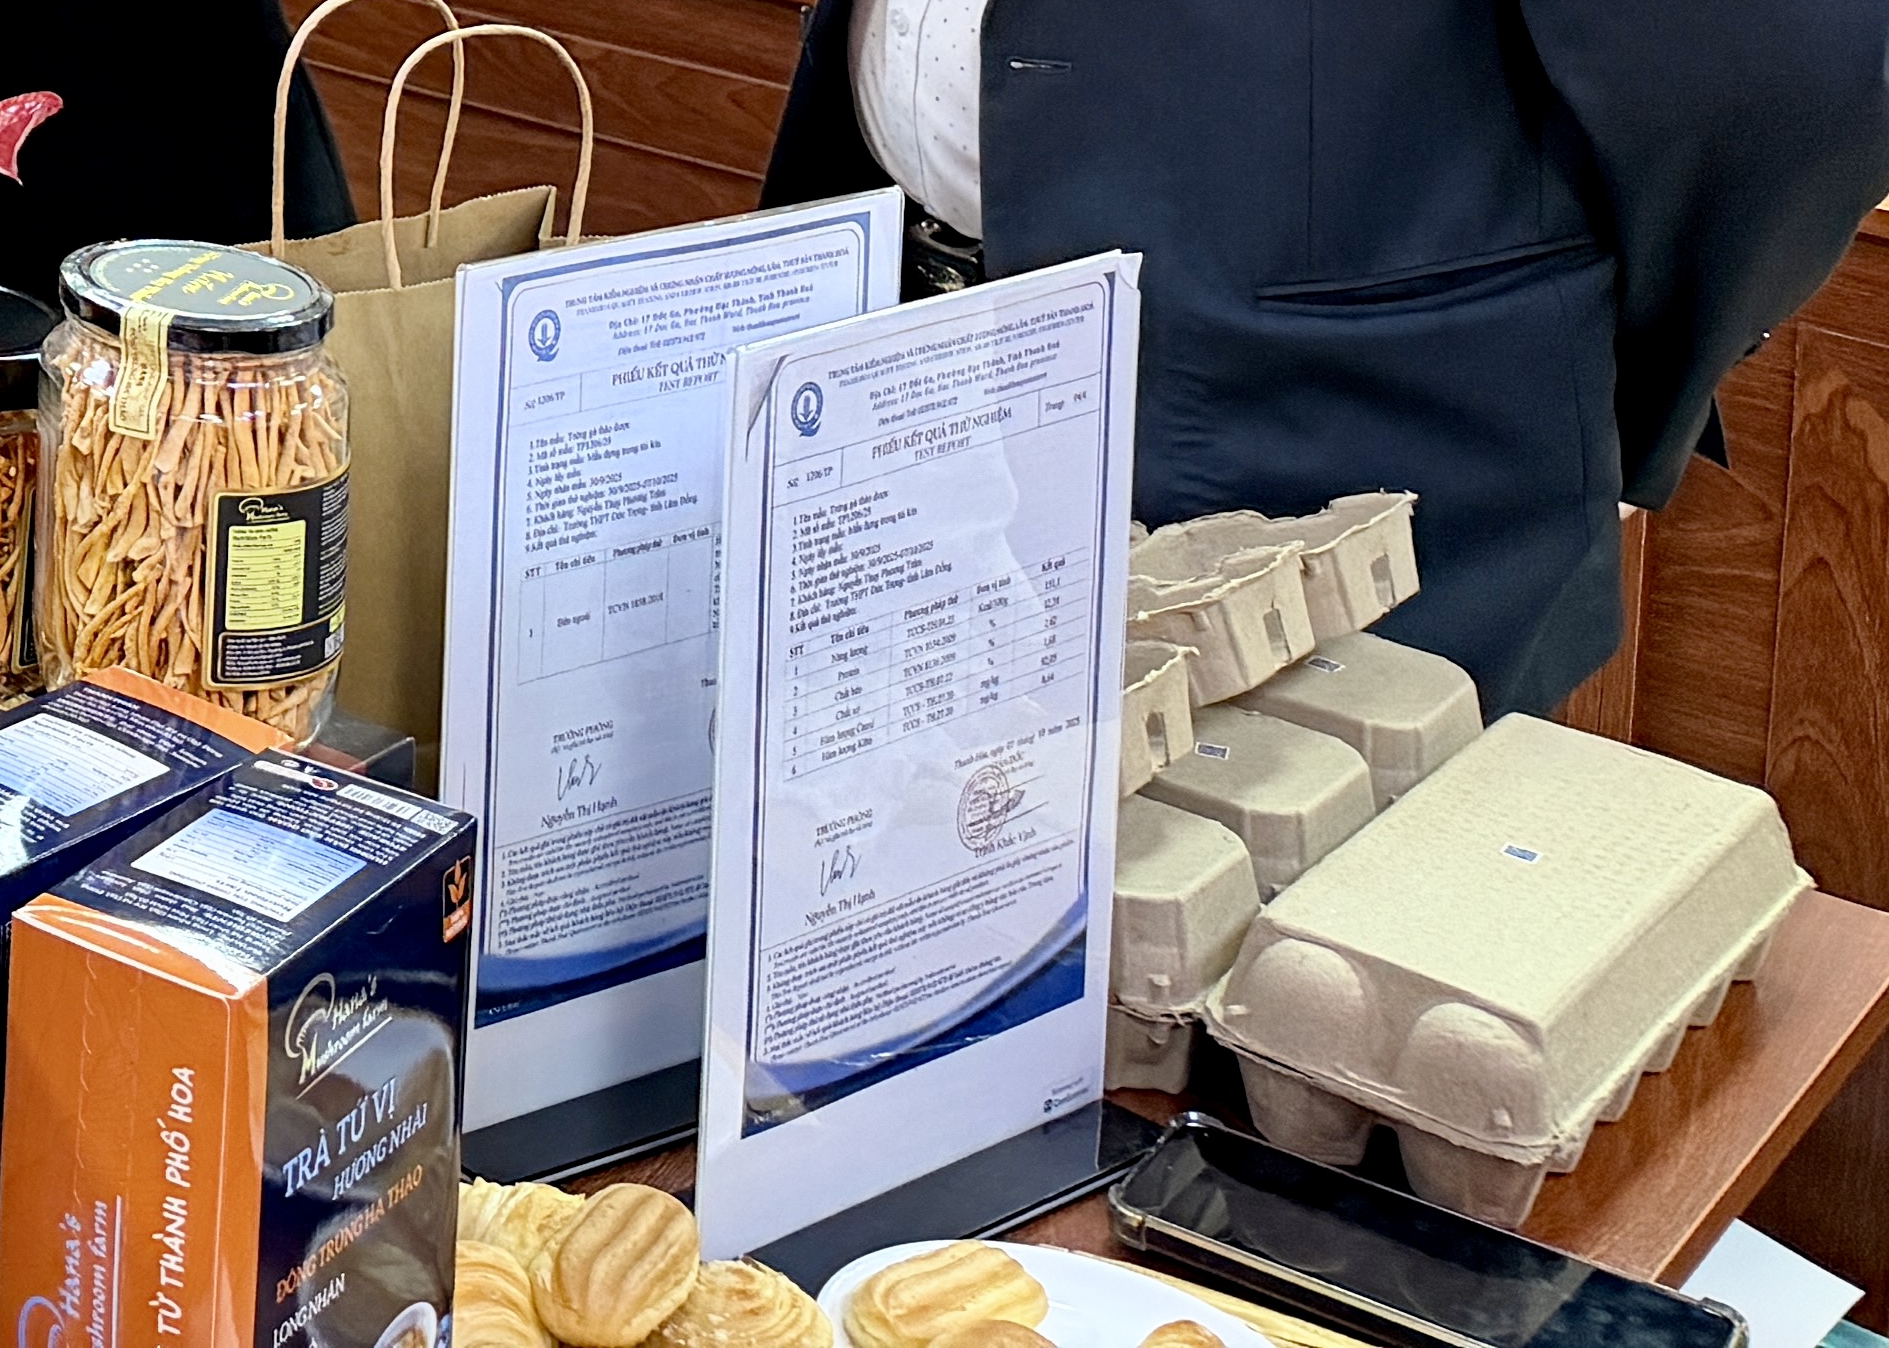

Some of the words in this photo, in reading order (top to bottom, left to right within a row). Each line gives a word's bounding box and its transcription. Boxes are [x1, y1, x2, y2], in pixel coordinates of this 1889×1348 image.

[612, 366, 644, 386] PHIẾU
[646, 361, 667, 380] KẾT
[670, 355, 693, 376] QUẢ
[903, 427, 923, 450] KẾT
[924, 417, 945, 443] QUẢ
[331, 974, 379, 1031] Hana's
[298, 1022, 362, 1086] Mushroom
[362, 997, 389, 1036] farm
[166, 1066, 195, 1124] HOA
[157, 1117, 192, 1189] PHỐ
[282, 1128, 331, 1198] TRÀ
[336, 1093, 370, 1156] TỨ
[371, 1076, 397, 1122] VỊ
[332, 1141, 388, 1201] HƯƠNG
[87, 1200, 108, 1258] farm
[152, 1196, 188, 1288] THÀNH
[58, 1212, 81, 1320] Hana's
[276, 1258, 317, 1303] ĐÔNG
[317, 1217, 365, 1264] TRÙNG
[149, 1291, 182, 1336] TỪ
